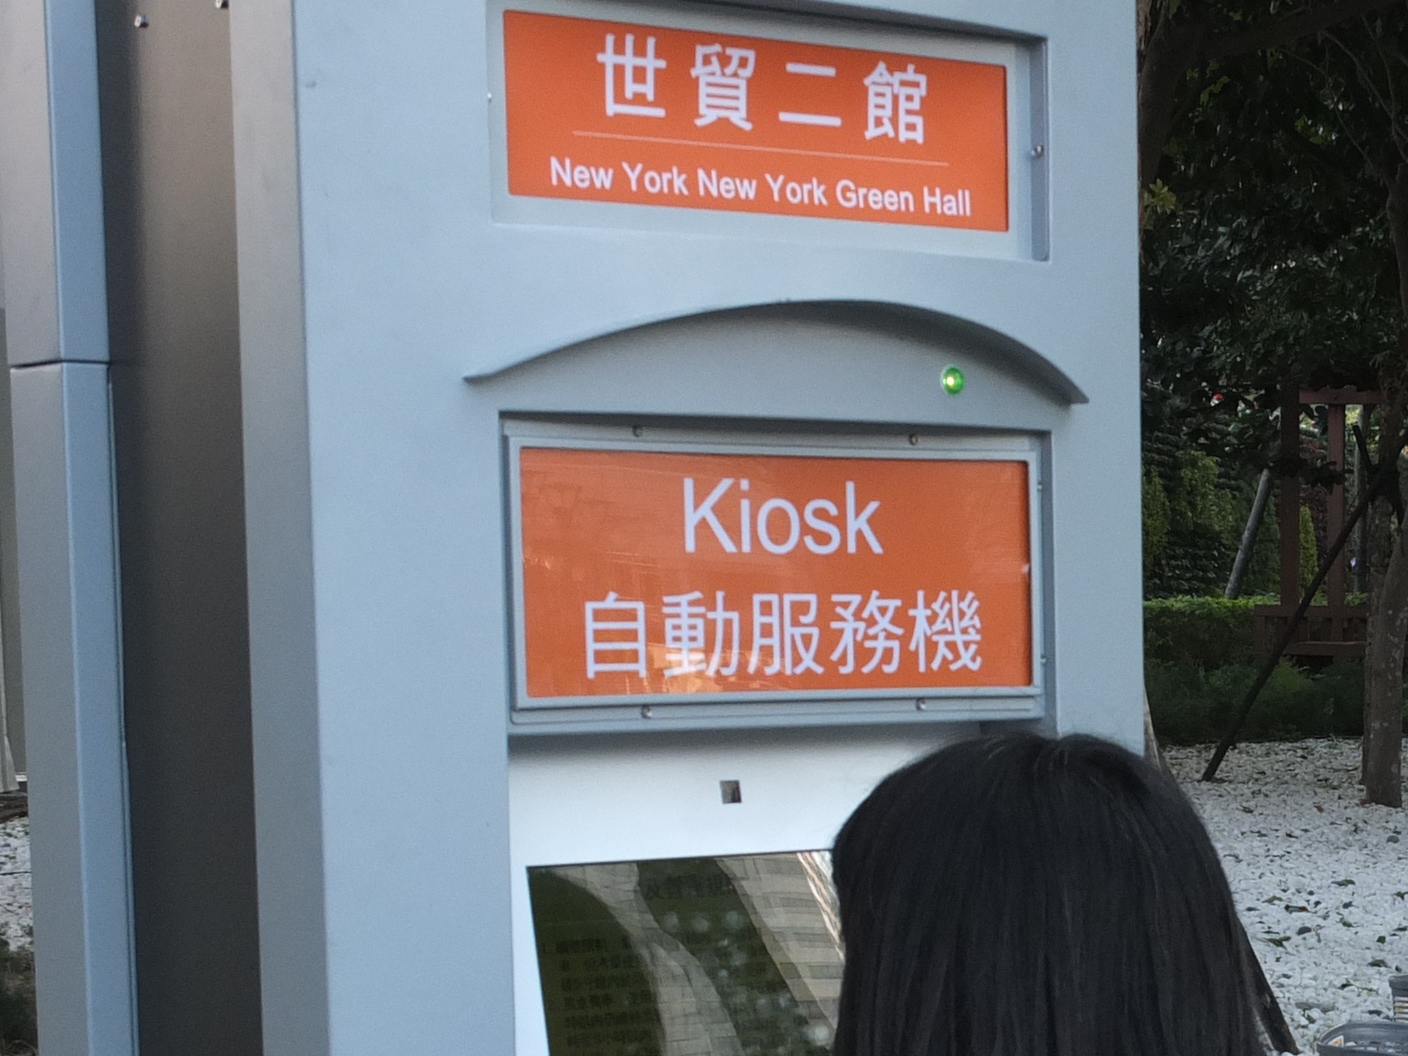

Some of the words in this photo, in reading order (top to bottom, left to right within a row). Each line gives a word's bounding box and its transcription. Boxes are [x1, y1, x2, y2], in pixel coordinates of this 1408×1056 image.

[597, 33, 928, 145] 世貿二館
[550, 157, 612, 189] New
[621, 163, 688, 197] York
[698, 168, 760, 201] New
[765, 174, 828, 206] York
[836, 180, 914, 214] Green
[924, 188, 972, 217] Hall
[682, 477, 884, 556] Kiosk
[583, 590, 982, 680] 自動服務機
